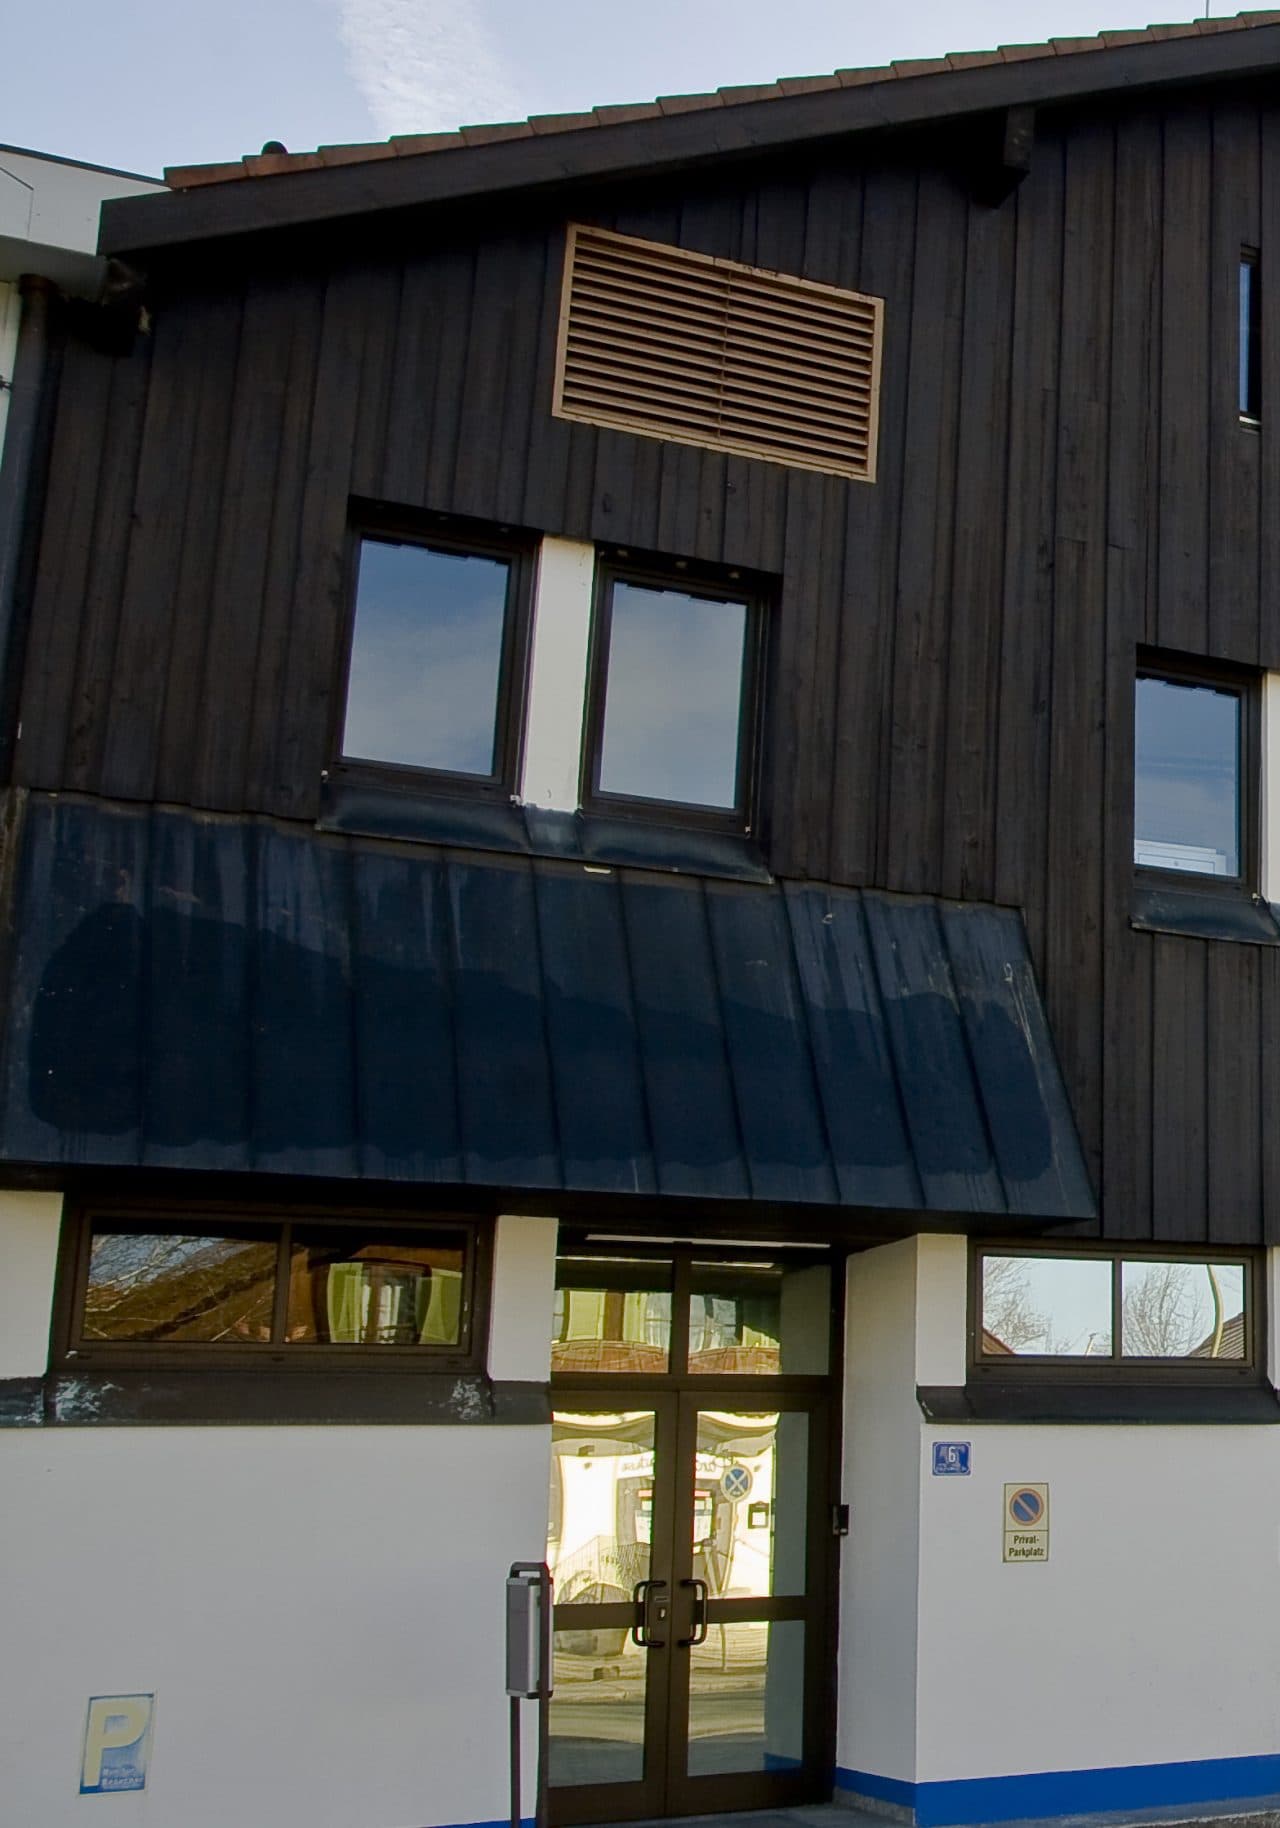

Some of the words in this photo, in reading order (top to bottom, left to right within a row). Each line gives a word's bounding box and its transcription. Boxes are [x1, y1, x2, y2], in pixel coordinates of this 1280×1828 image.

[948, 1446, 956, 1463] 6
[1013, 1535, 1039, 1545] Privat-
[1008, 1547, 1044, 1558] Parkplatz
[83, 1700, 147, 1787] P
